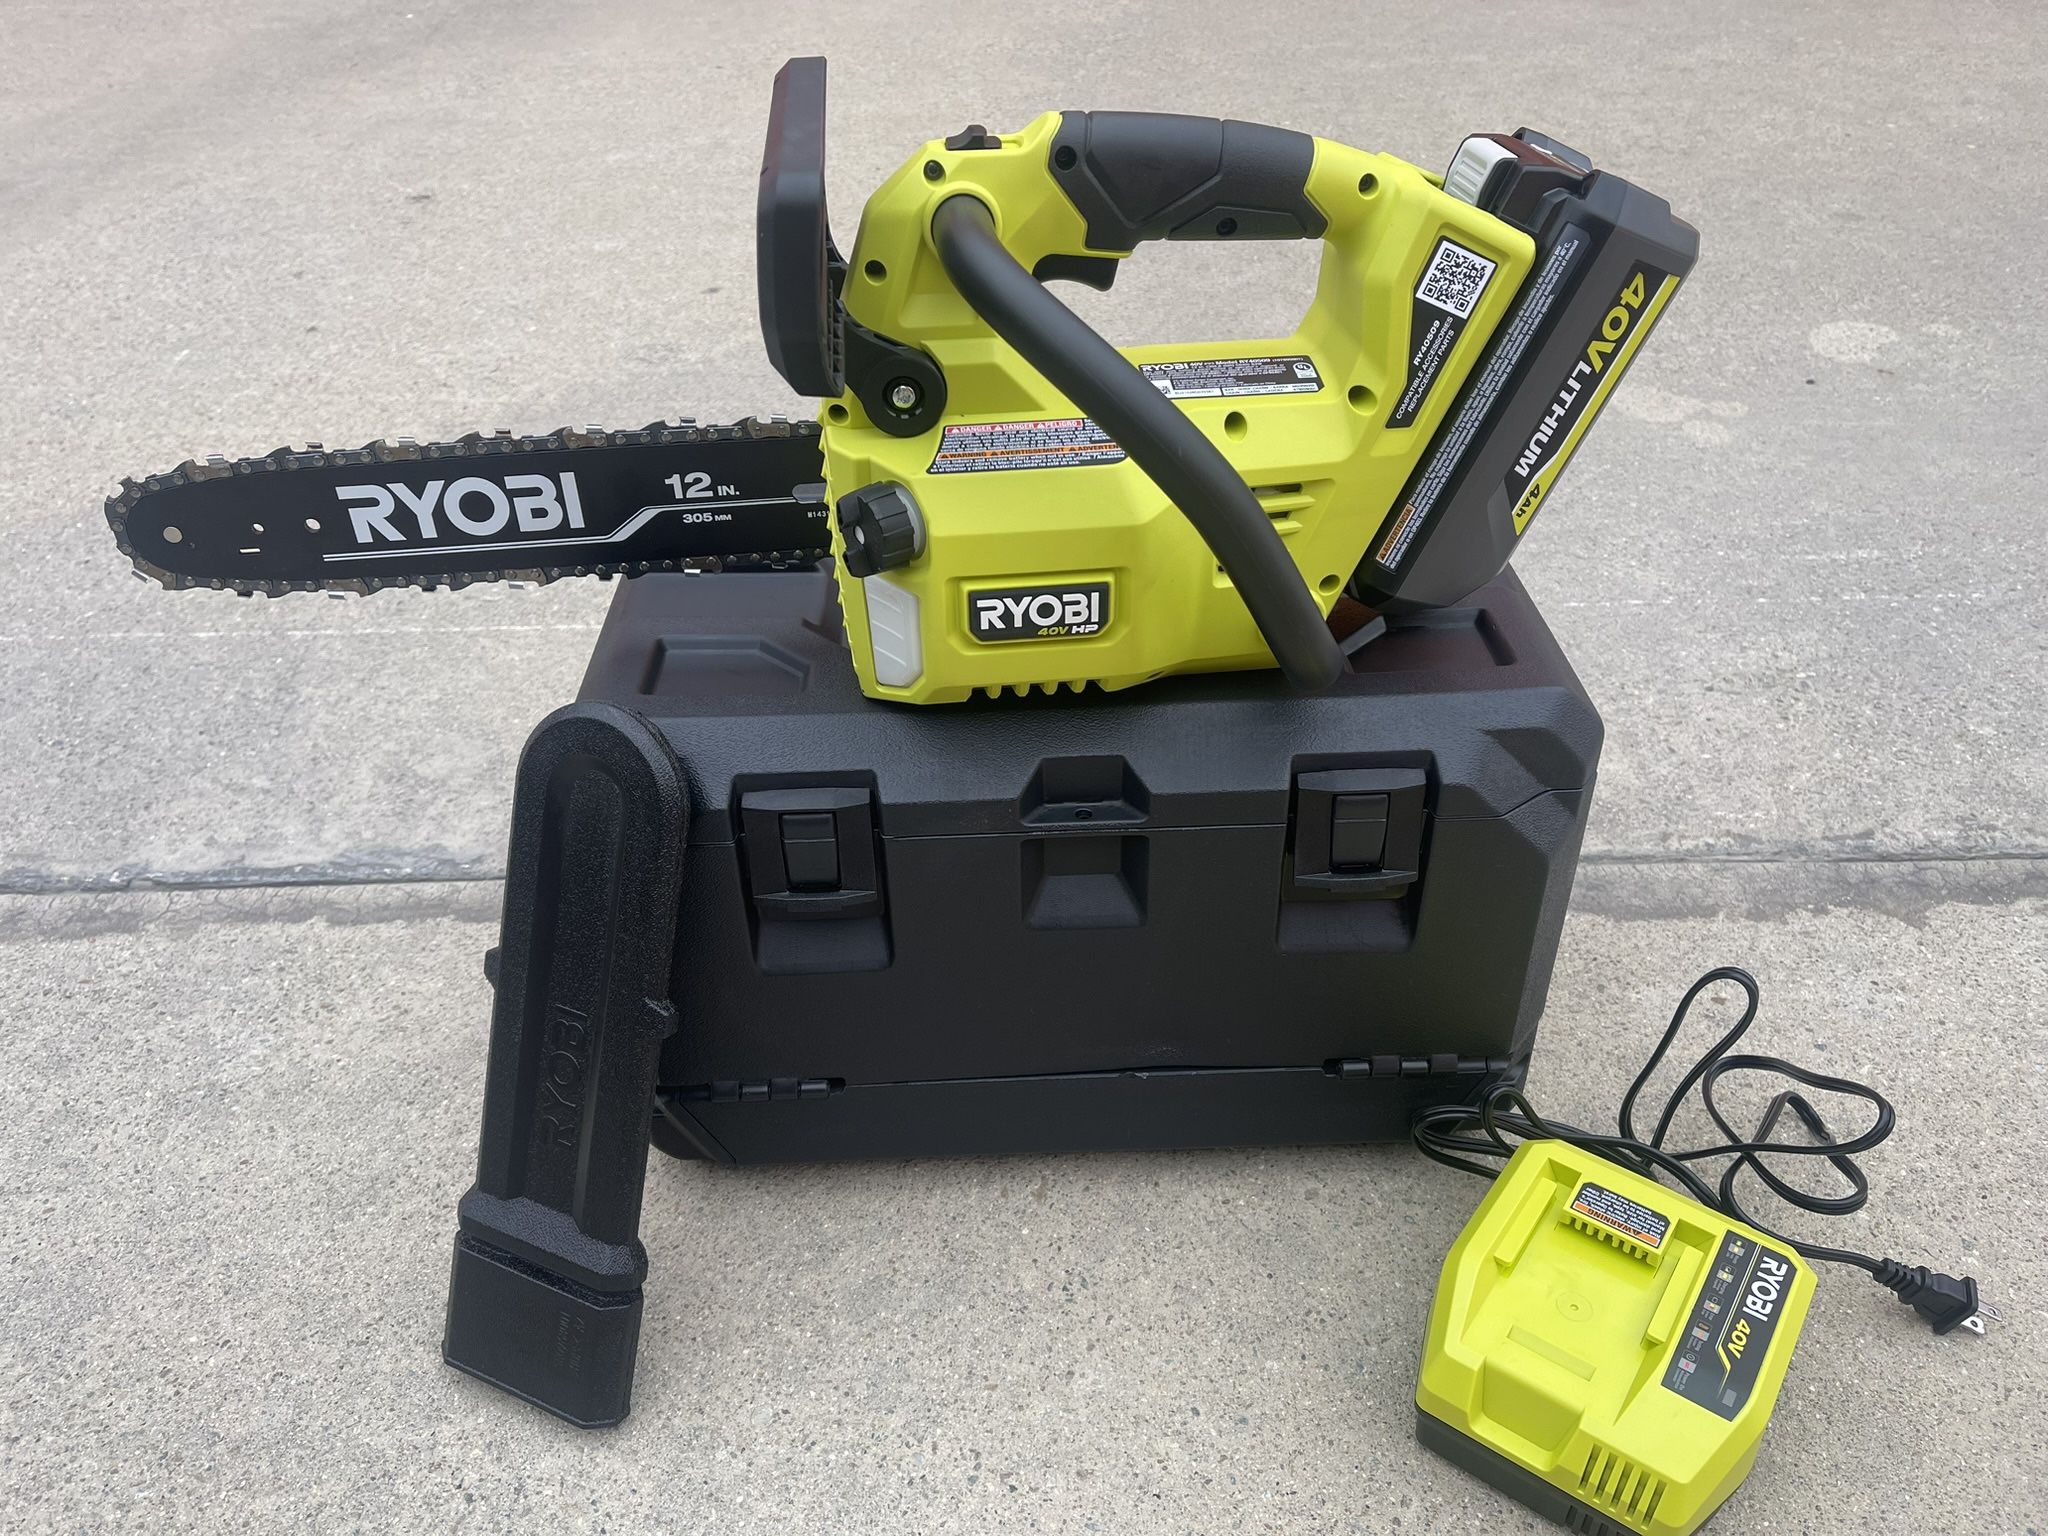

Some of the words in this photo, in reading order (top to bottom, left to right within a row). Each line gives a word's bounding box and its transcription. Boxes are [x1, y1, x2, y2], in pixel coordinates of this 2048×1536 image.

[1412, 319, 1441, 366] RY40509
[1587, 272, 1645, 374] 40V
[1140, 362, 1188, 371] RYOBI
[1394, 370, 1424, 419] COMPATIBLE
[1421, 316, 1453, 371] ACCESSORIES
[1407, 355, 1440, 412] REPLACEMENT
[1437, 328, 1455, 355] PARTS
[1514, 360, 1592, 477] LITHIUM
[1000, 447, 1063, 455] AVERTISSEMENT
[335, 471, 585, 543] RYOBI
[664, 471, 714, 499] 12
[717, 485, 740, 497] IN.
[1516, 483, 1540, 518] 4Ah
[682, 512, 713, 524] 305
[714, 513, 732, 522] MM
[1382, 506, 1413, 553] ADVERTENCIA
[976, 592, 1100, 630] RYOBI
[1038, 626, 1069, 636] 40V
[1071, 624, 1099, 634] HP
[541, 1002, 589, 1146] RYOBI
[1586, 1208, 1633, 1233] WARNING
[1742, 1256, 1788, 1321] RYOBI
[1727, 1318, 1751, 1359] 40V
